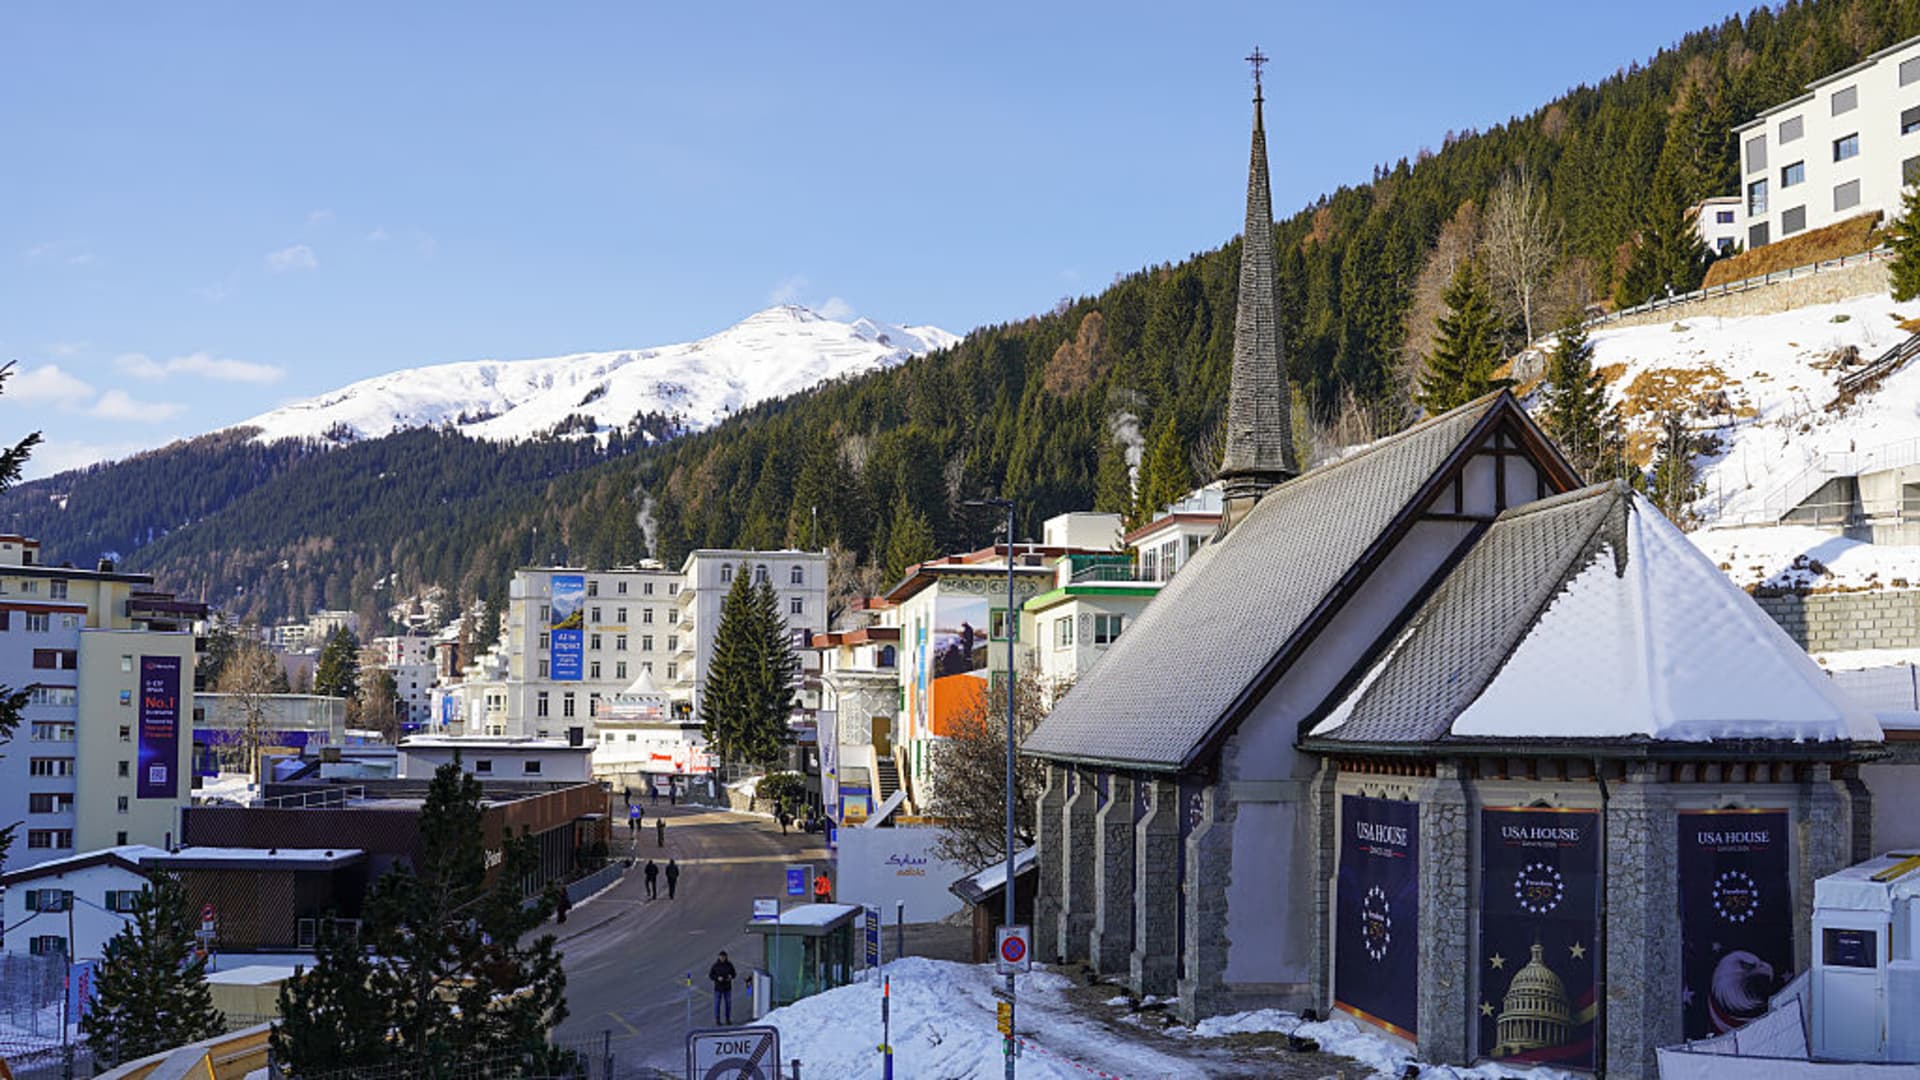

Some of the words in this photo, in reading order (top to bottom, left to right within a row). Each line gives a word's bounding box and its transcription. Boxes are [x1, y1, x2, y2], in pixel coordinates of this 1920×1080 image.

[145, 696, 174, 709] No.1
[1357, 820, 1375, 841] USA
[1375, 824, 1408, 846] HOUSE
[1501, 826, 1528, 839] USA
[1530, 827, 1580, 841] HOUSE
[1698, 831, 1723, 845] USA
[1725, 831, 1771, 843] HOUSE
[714, 1040, 751, 1055] ZONE
